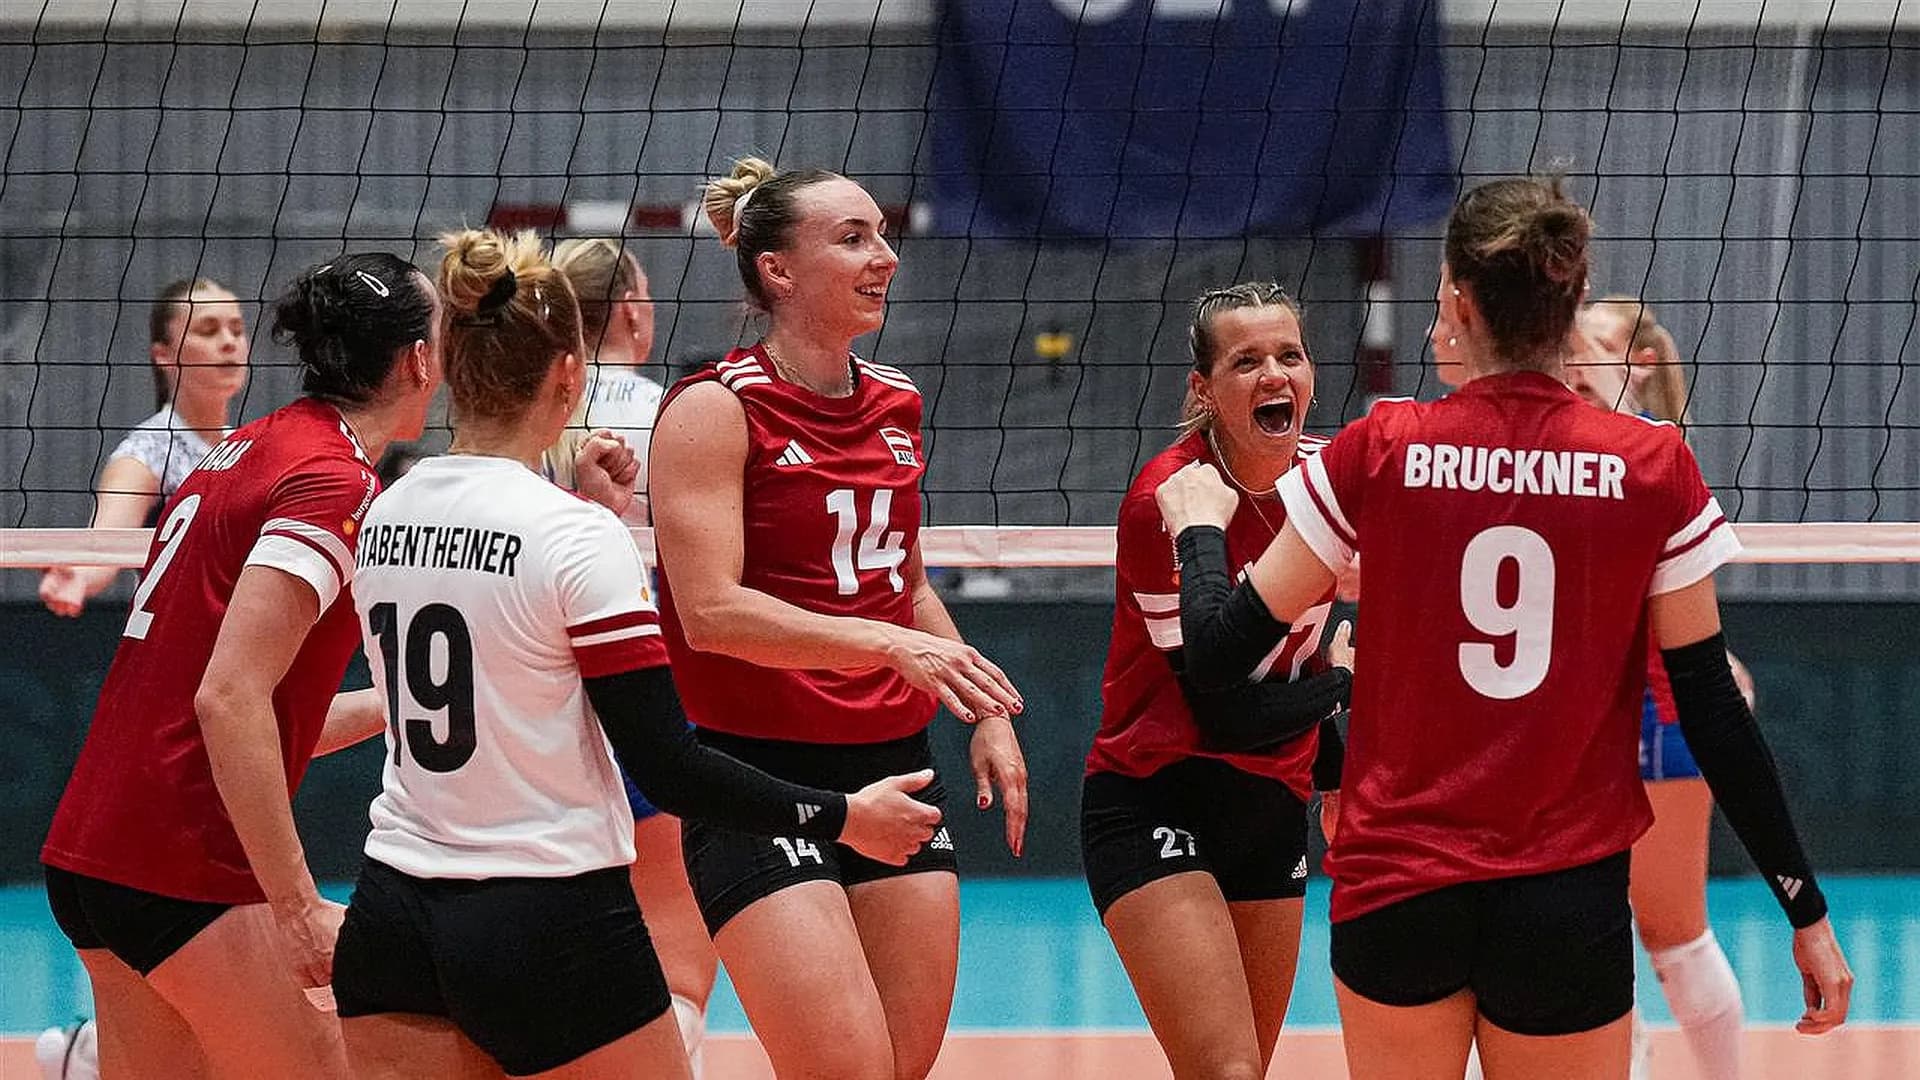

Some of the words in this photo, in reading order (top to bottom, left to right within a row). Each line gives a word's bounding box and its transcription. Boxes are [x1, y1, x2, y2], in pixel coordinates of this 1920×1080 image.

[1404, 444, 1626, 500] BRUCKNER
[123, 494, 201, 640] 2
[357, 525, 522, 577] TABENTHEINER
[826, 489, 907, 595] 14
[1459, 525, 1556, 700] 9
[369, 602, 477, 773] 19
[773, 837, 823, 868] 14
